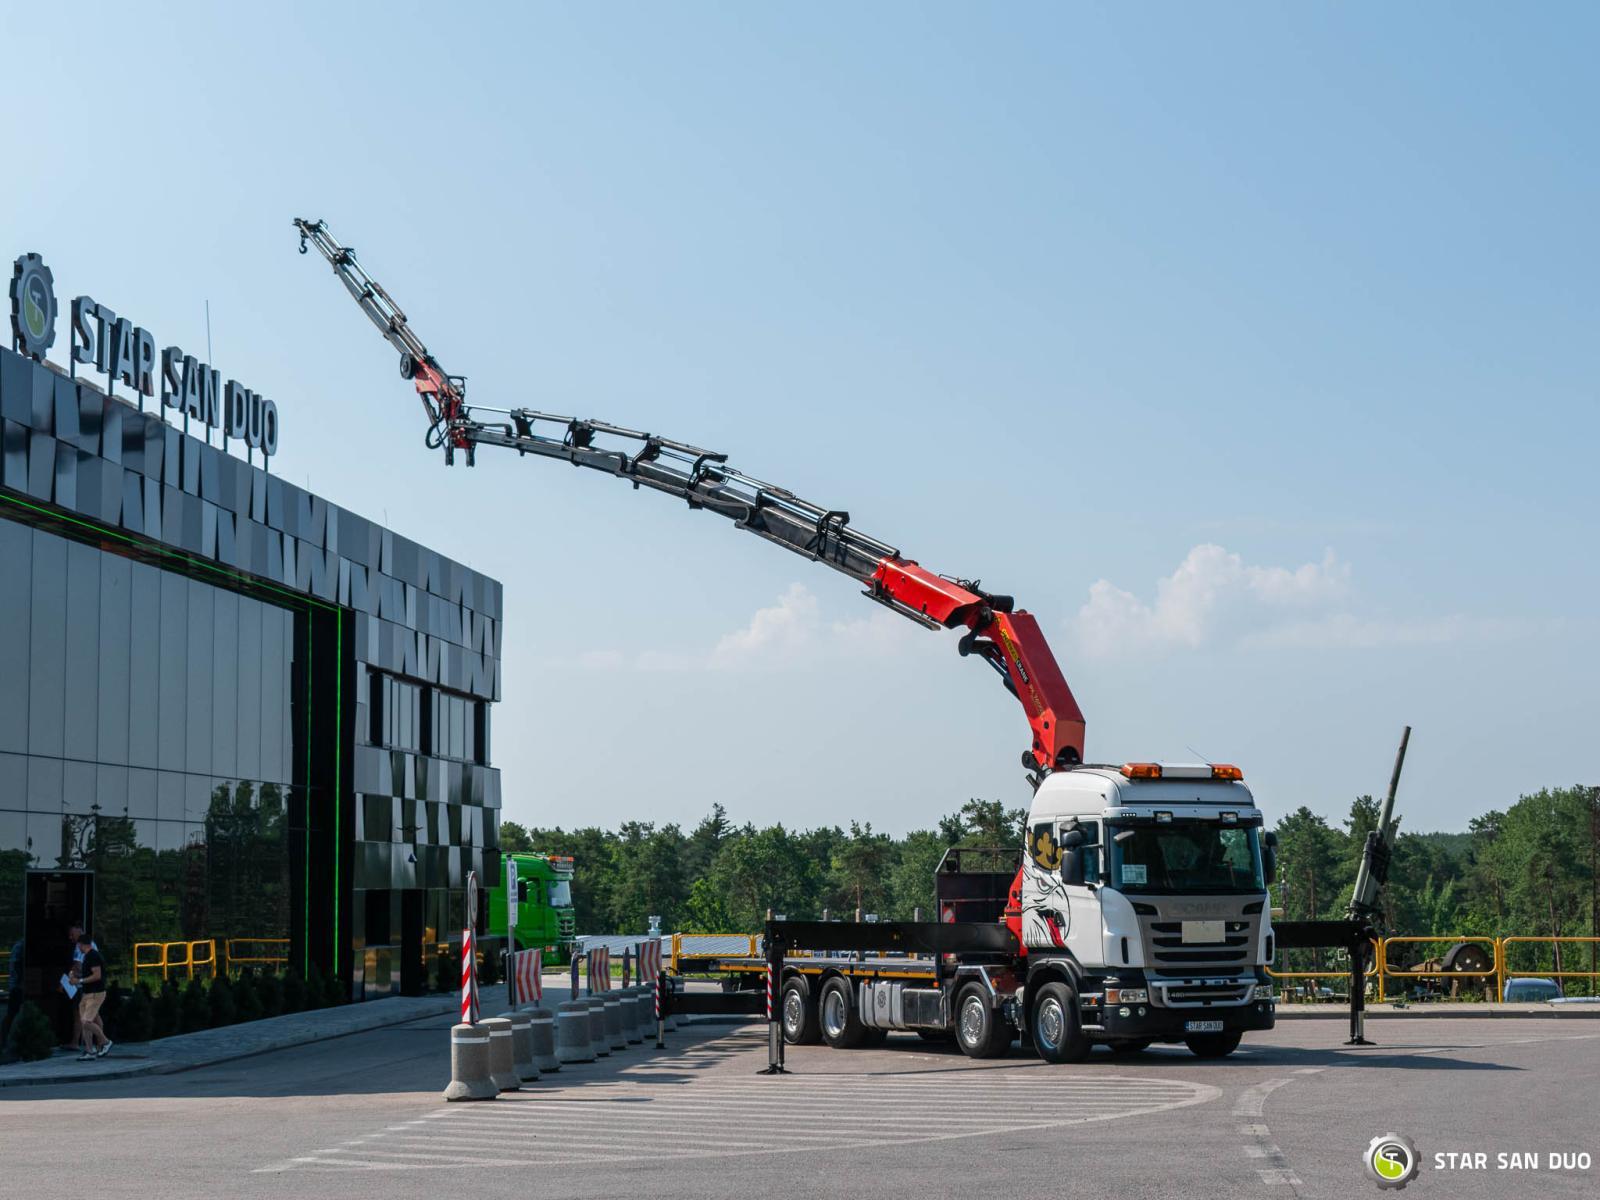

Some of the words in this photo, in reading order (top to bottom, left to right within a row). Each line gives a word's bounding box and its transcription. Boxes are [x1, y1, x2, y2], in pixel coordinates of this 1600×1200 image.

[72, 296, 155, 397] STAR
[162, 346, 220, 428] SAN
[225, 380, 278, 456] DUO
